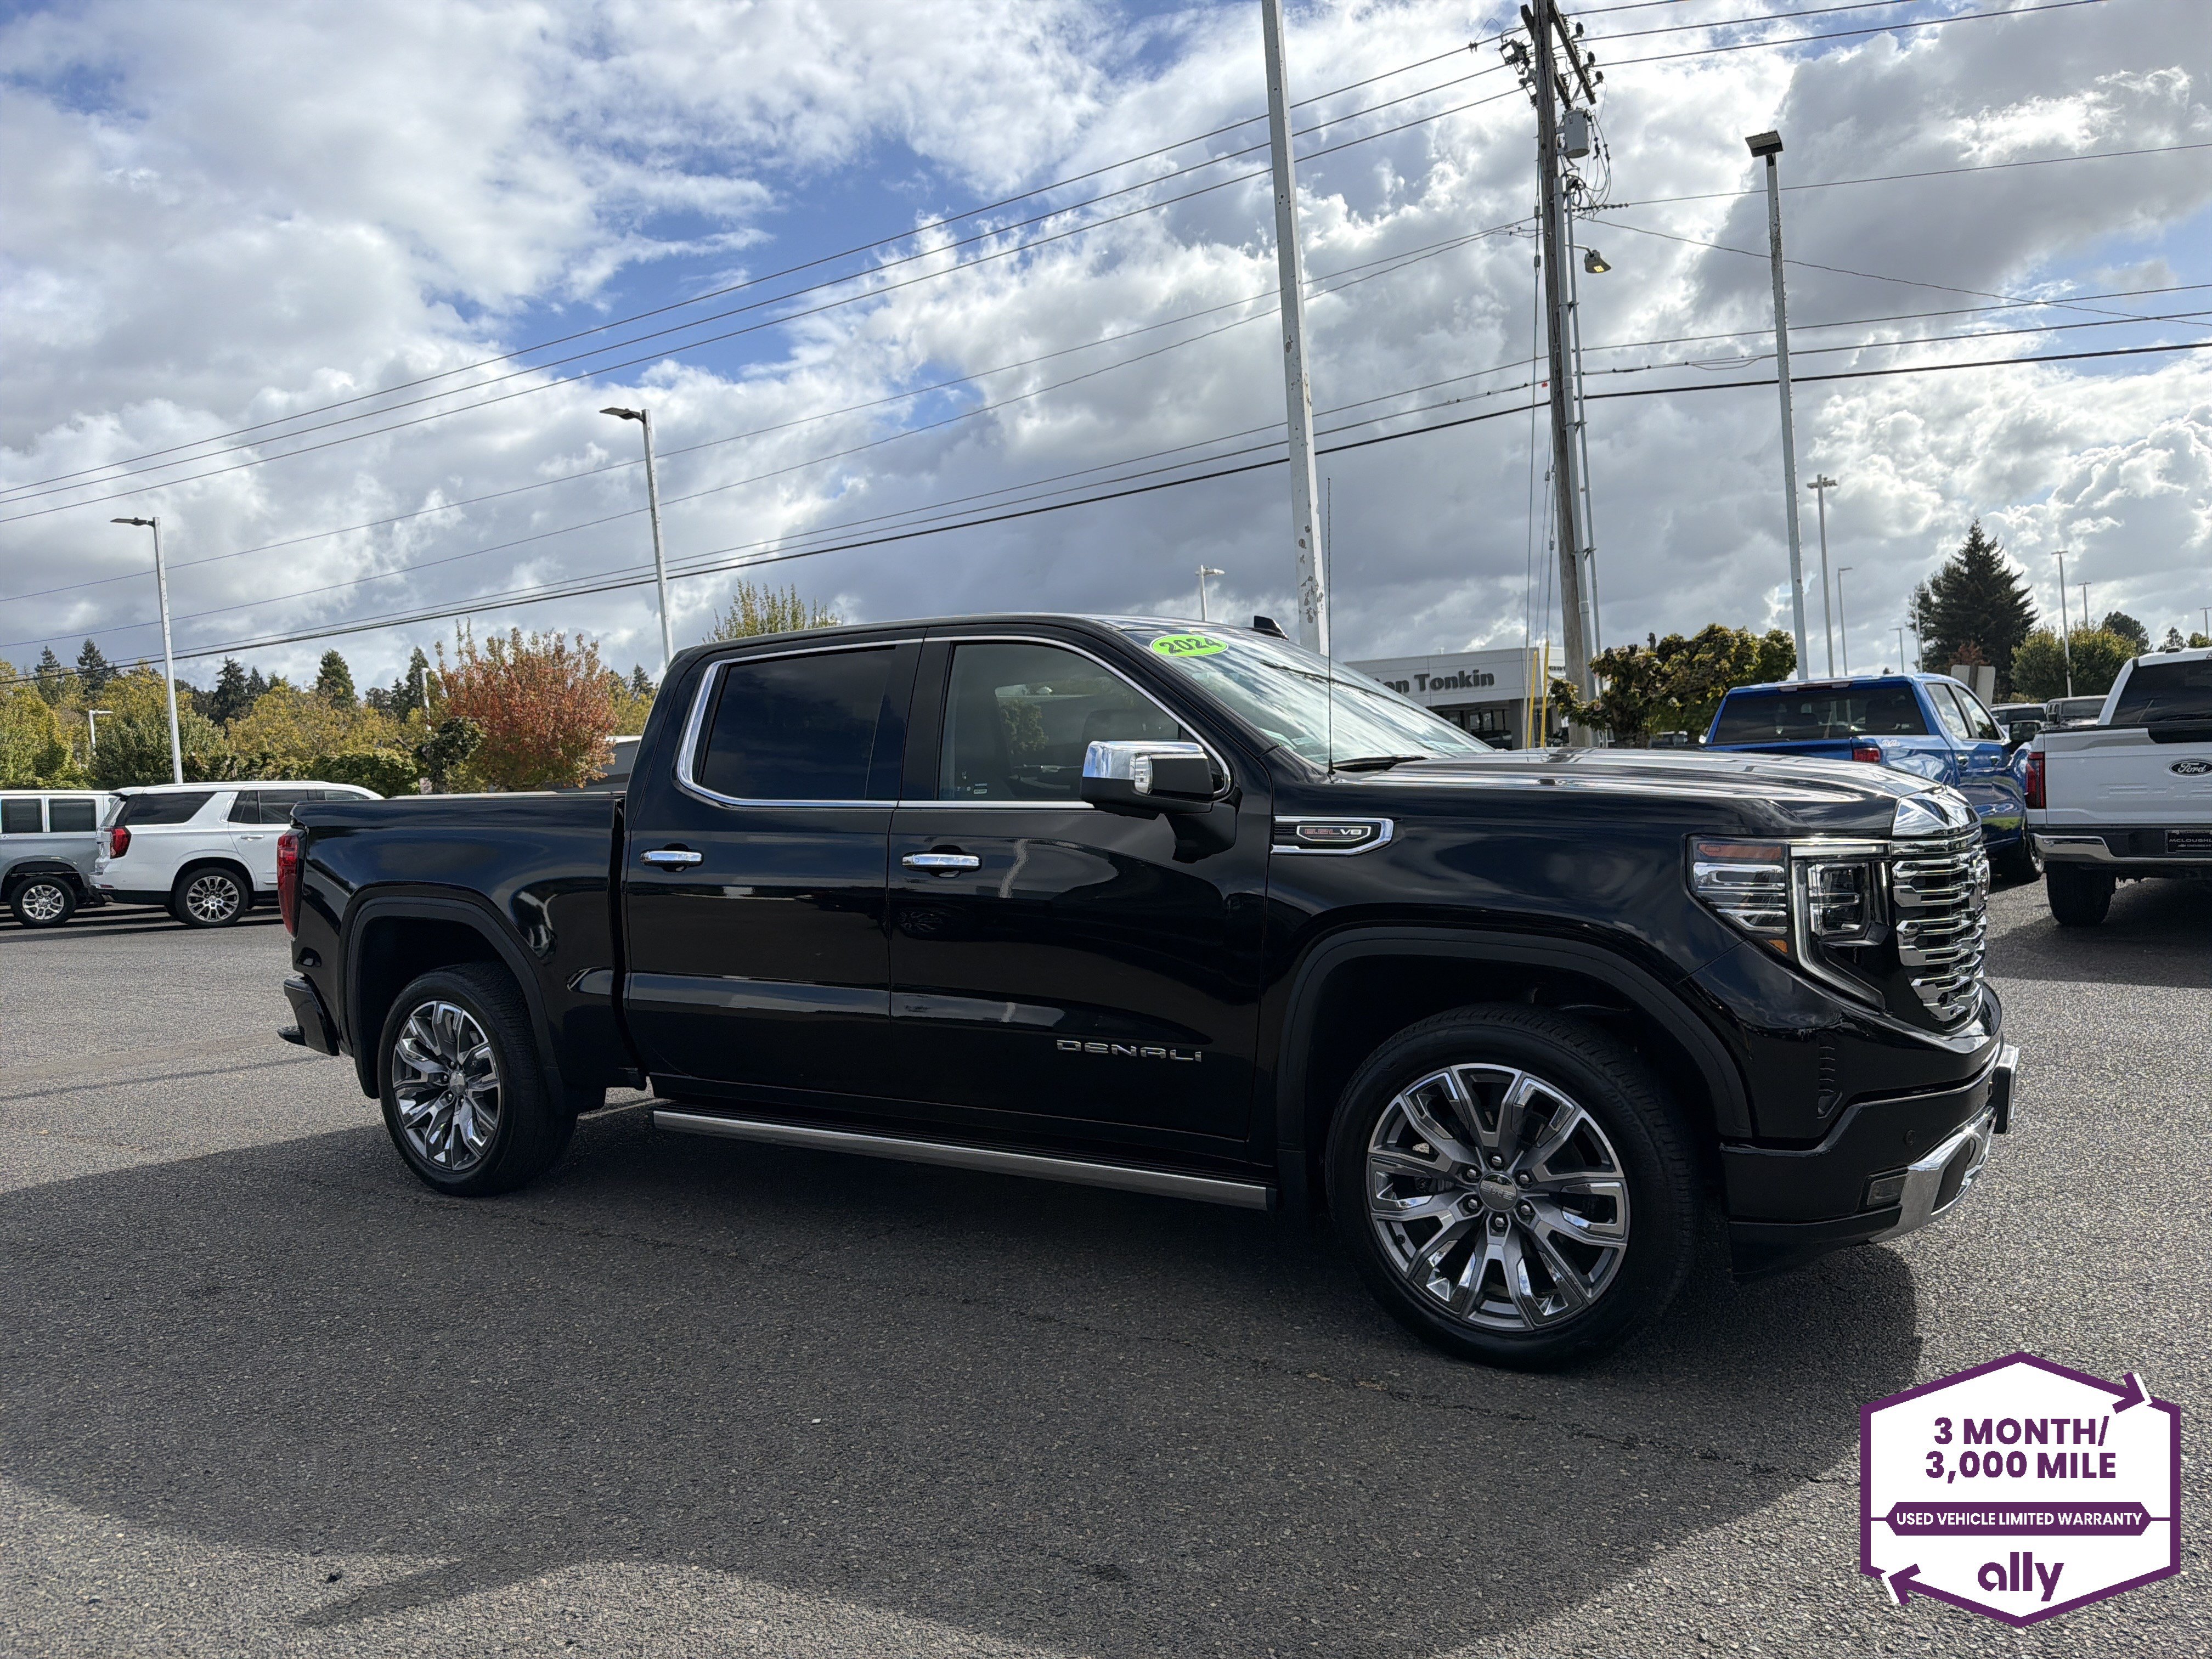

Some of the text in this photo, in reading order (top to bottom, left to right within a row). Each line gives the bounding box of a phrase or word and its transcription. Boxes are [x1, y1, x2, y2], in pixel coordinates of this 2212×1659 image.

[1159, 638, 1222, 654] 2024
[1414, 669, 1495, 692] Tonkin
[2177, 762, 2207, 773] Ford
[1056, 1040, 1202, 1063] DENALI
